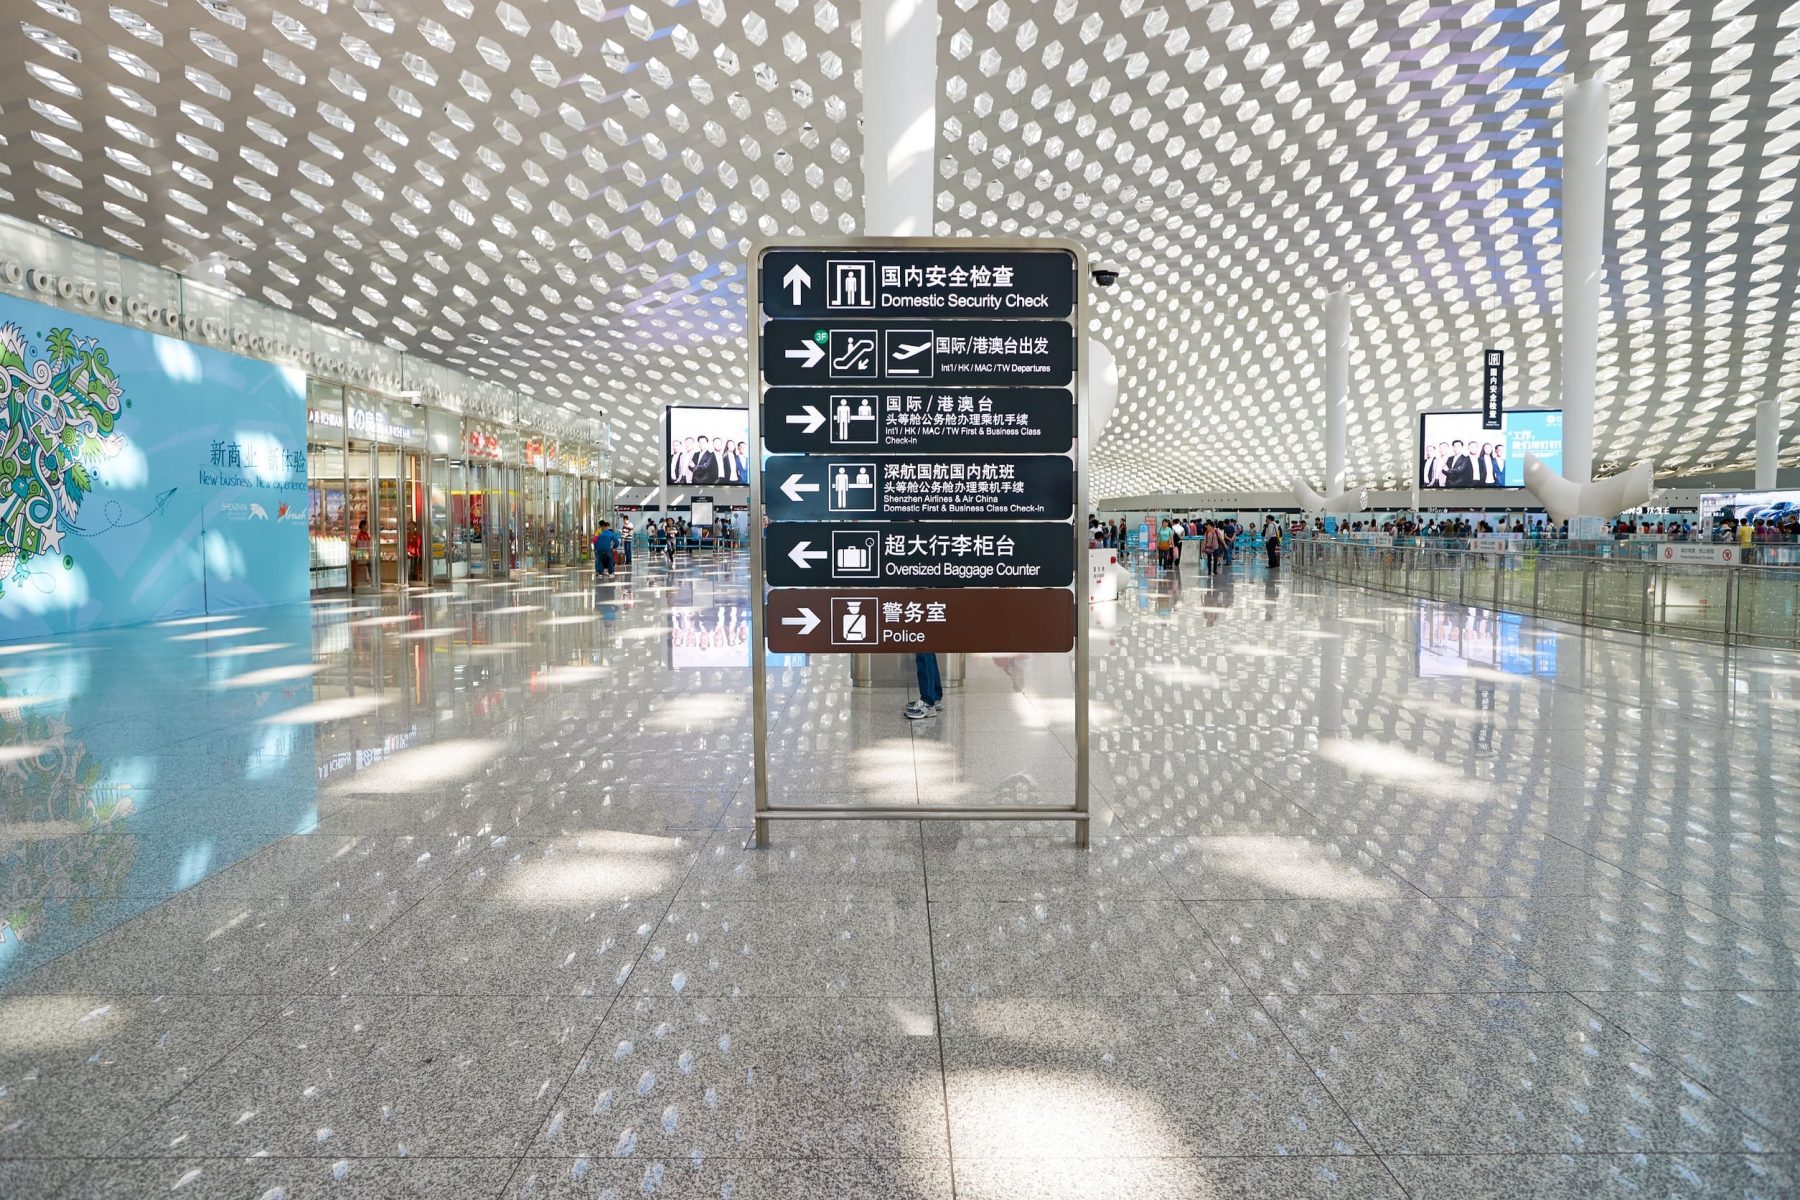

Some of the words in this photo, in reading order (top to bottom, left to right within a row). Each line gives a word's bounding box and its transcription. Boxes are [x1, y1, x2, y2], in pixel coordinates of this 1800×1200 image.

[881, 265, 1015, 288] 国内安全检查
[882, 294, 945, 307] Domestic
[948, 293, 1002, 311] Security
[1006, 293, 1049, 308] Check
[815, 332, 828, 343] 3F
[936, 336, 1049, 355] 国际/港澳台出发
[958, 363, 970, 372] HK
[975, 363, 993, 372] MAC
[1011, 363, 1051, 374] Departures
[885, 413, 1029, 426] 头等舱公务舱办理乘机手续
[904, 427, 917, 436] HK
[922, 427, 941, 436] MAC
[946, 427, 960, 436] TW
[961, 427, 977, 436] First
[979, 427, 985, 436] &
[986, 427, 1020, 436] Business
[1021, 427, 1042, 436] Class
[885, 436, 918, 445] Check-in
[210, 439, 257, 468] 新商业
[267, 446, 306, 474] 新体验
[884, 463, 1015, 480] 深航国航国内航班
[199, 470, 218, 486] New
[220, 472, 253, 489] business
[883, 481, 1025, 494] 头等舱公务舱办理乘机手续
[883, 495, 922, 504] Shenzhen
[924, 495, 953, 504] Airlines
[955, 495, 961, 504] &
[963, 495, 973, 504] Air
[975, 495, 999, 504] China
[883, 504, 921, 513] Domestic
[922, 504, 939, 513] First
[941, 504, 947, 513] &
[949, 504, 985, 513] Business
[986, 504, 1008, 513] Class
[1010, 504, 1045, 513] Check-in
[884, 534, 1016, 557] 超大行李柜台
[886, 563, 941, 576] Oversized
[943, 563, 994, 579] Baggage
[996, 563, 1041, 576] Counter
[882, 601, 947, 623] 警务室
[883, 629, 925, 643] Police
